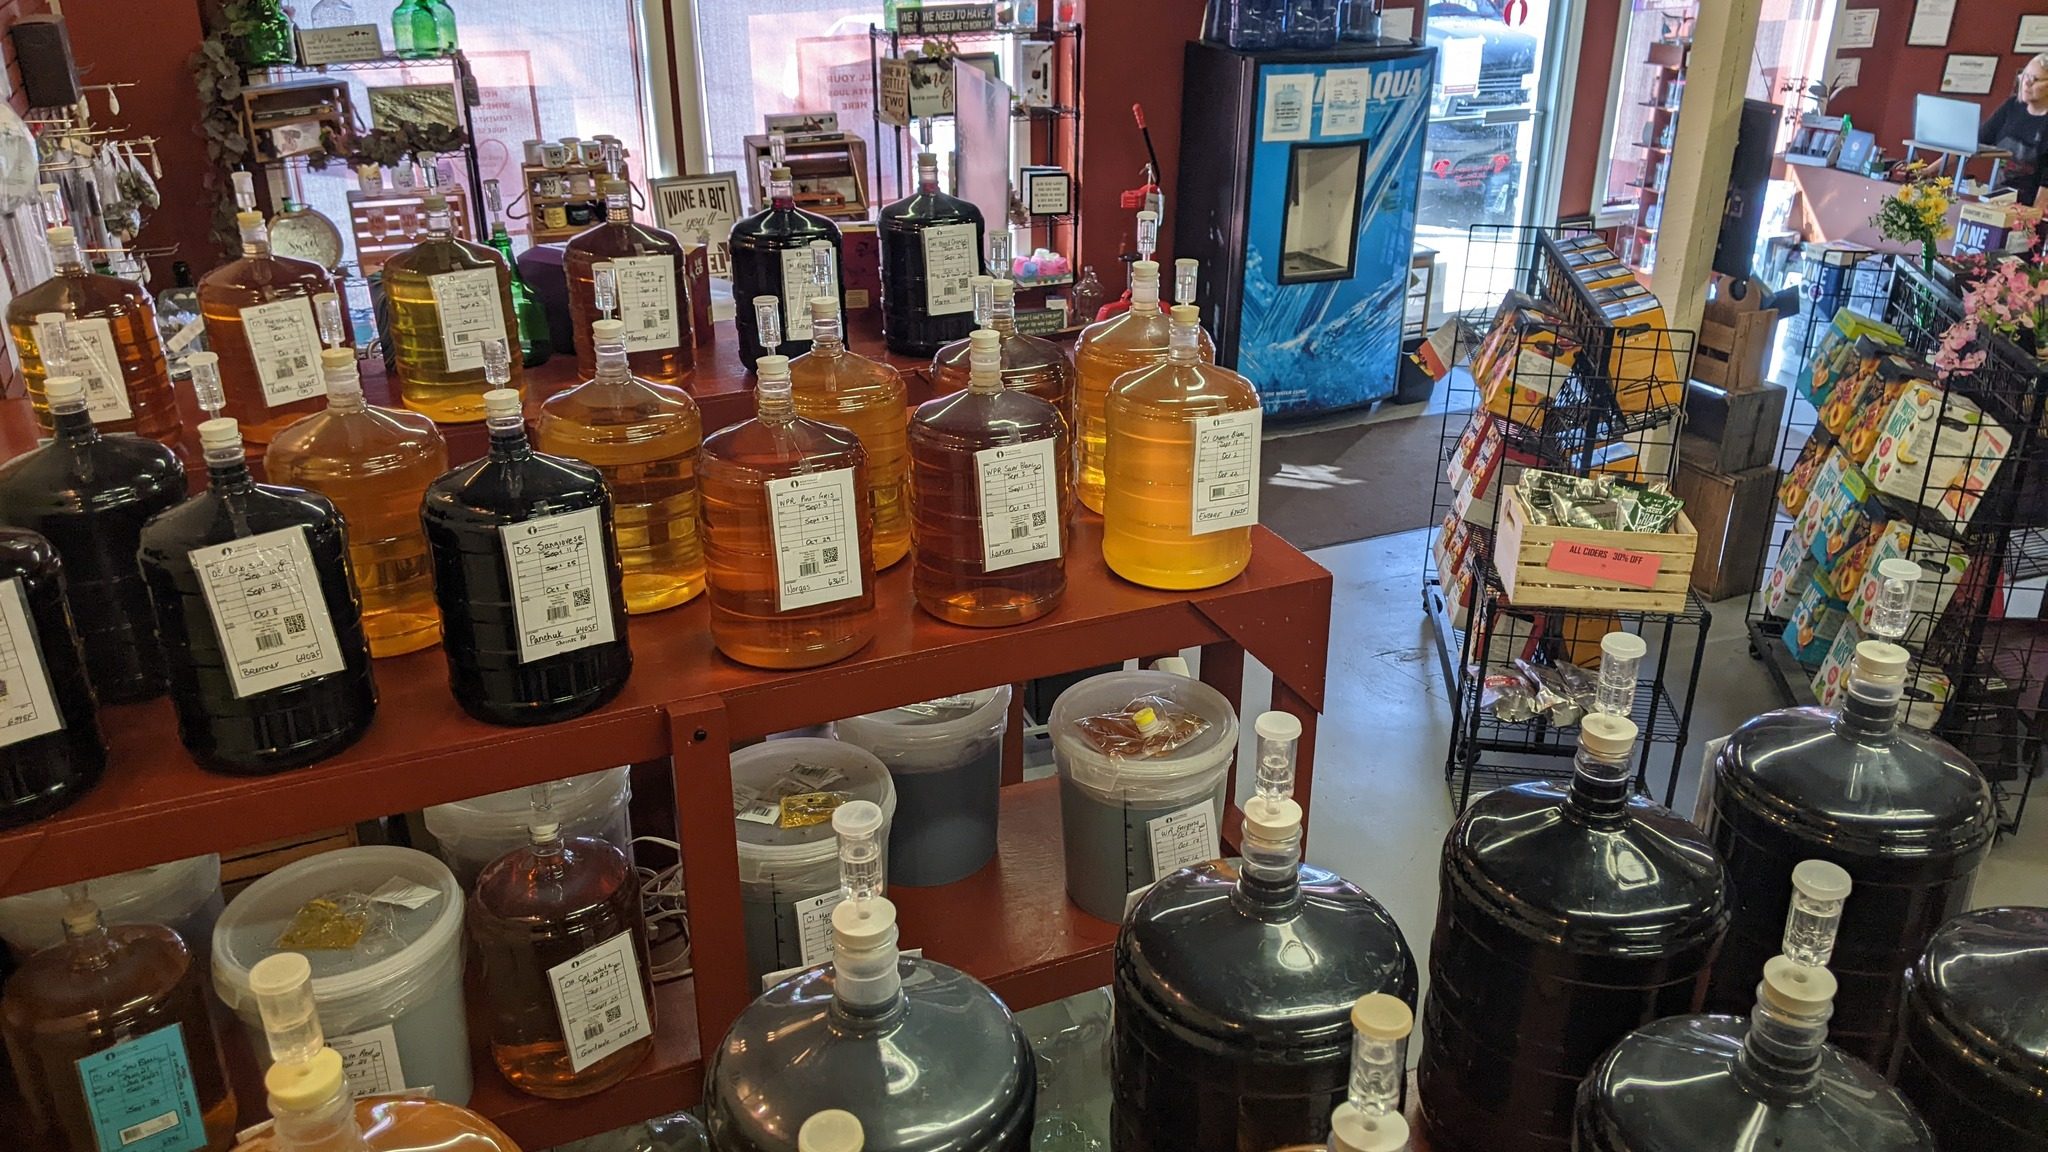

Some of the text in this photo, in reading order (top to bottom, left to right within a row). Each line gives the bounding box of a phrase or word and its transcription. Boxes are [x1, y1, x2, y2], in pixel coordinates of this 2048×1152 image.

[935, 9, 955, 21] NEED
[956, 8, 967, 20] TO
[967, 8, 987, 19] HAVE
[664, 186, 728, 219] WINE A BIT
[1569, 545, 1644, 565] ALL CIDERS 30% OFF
